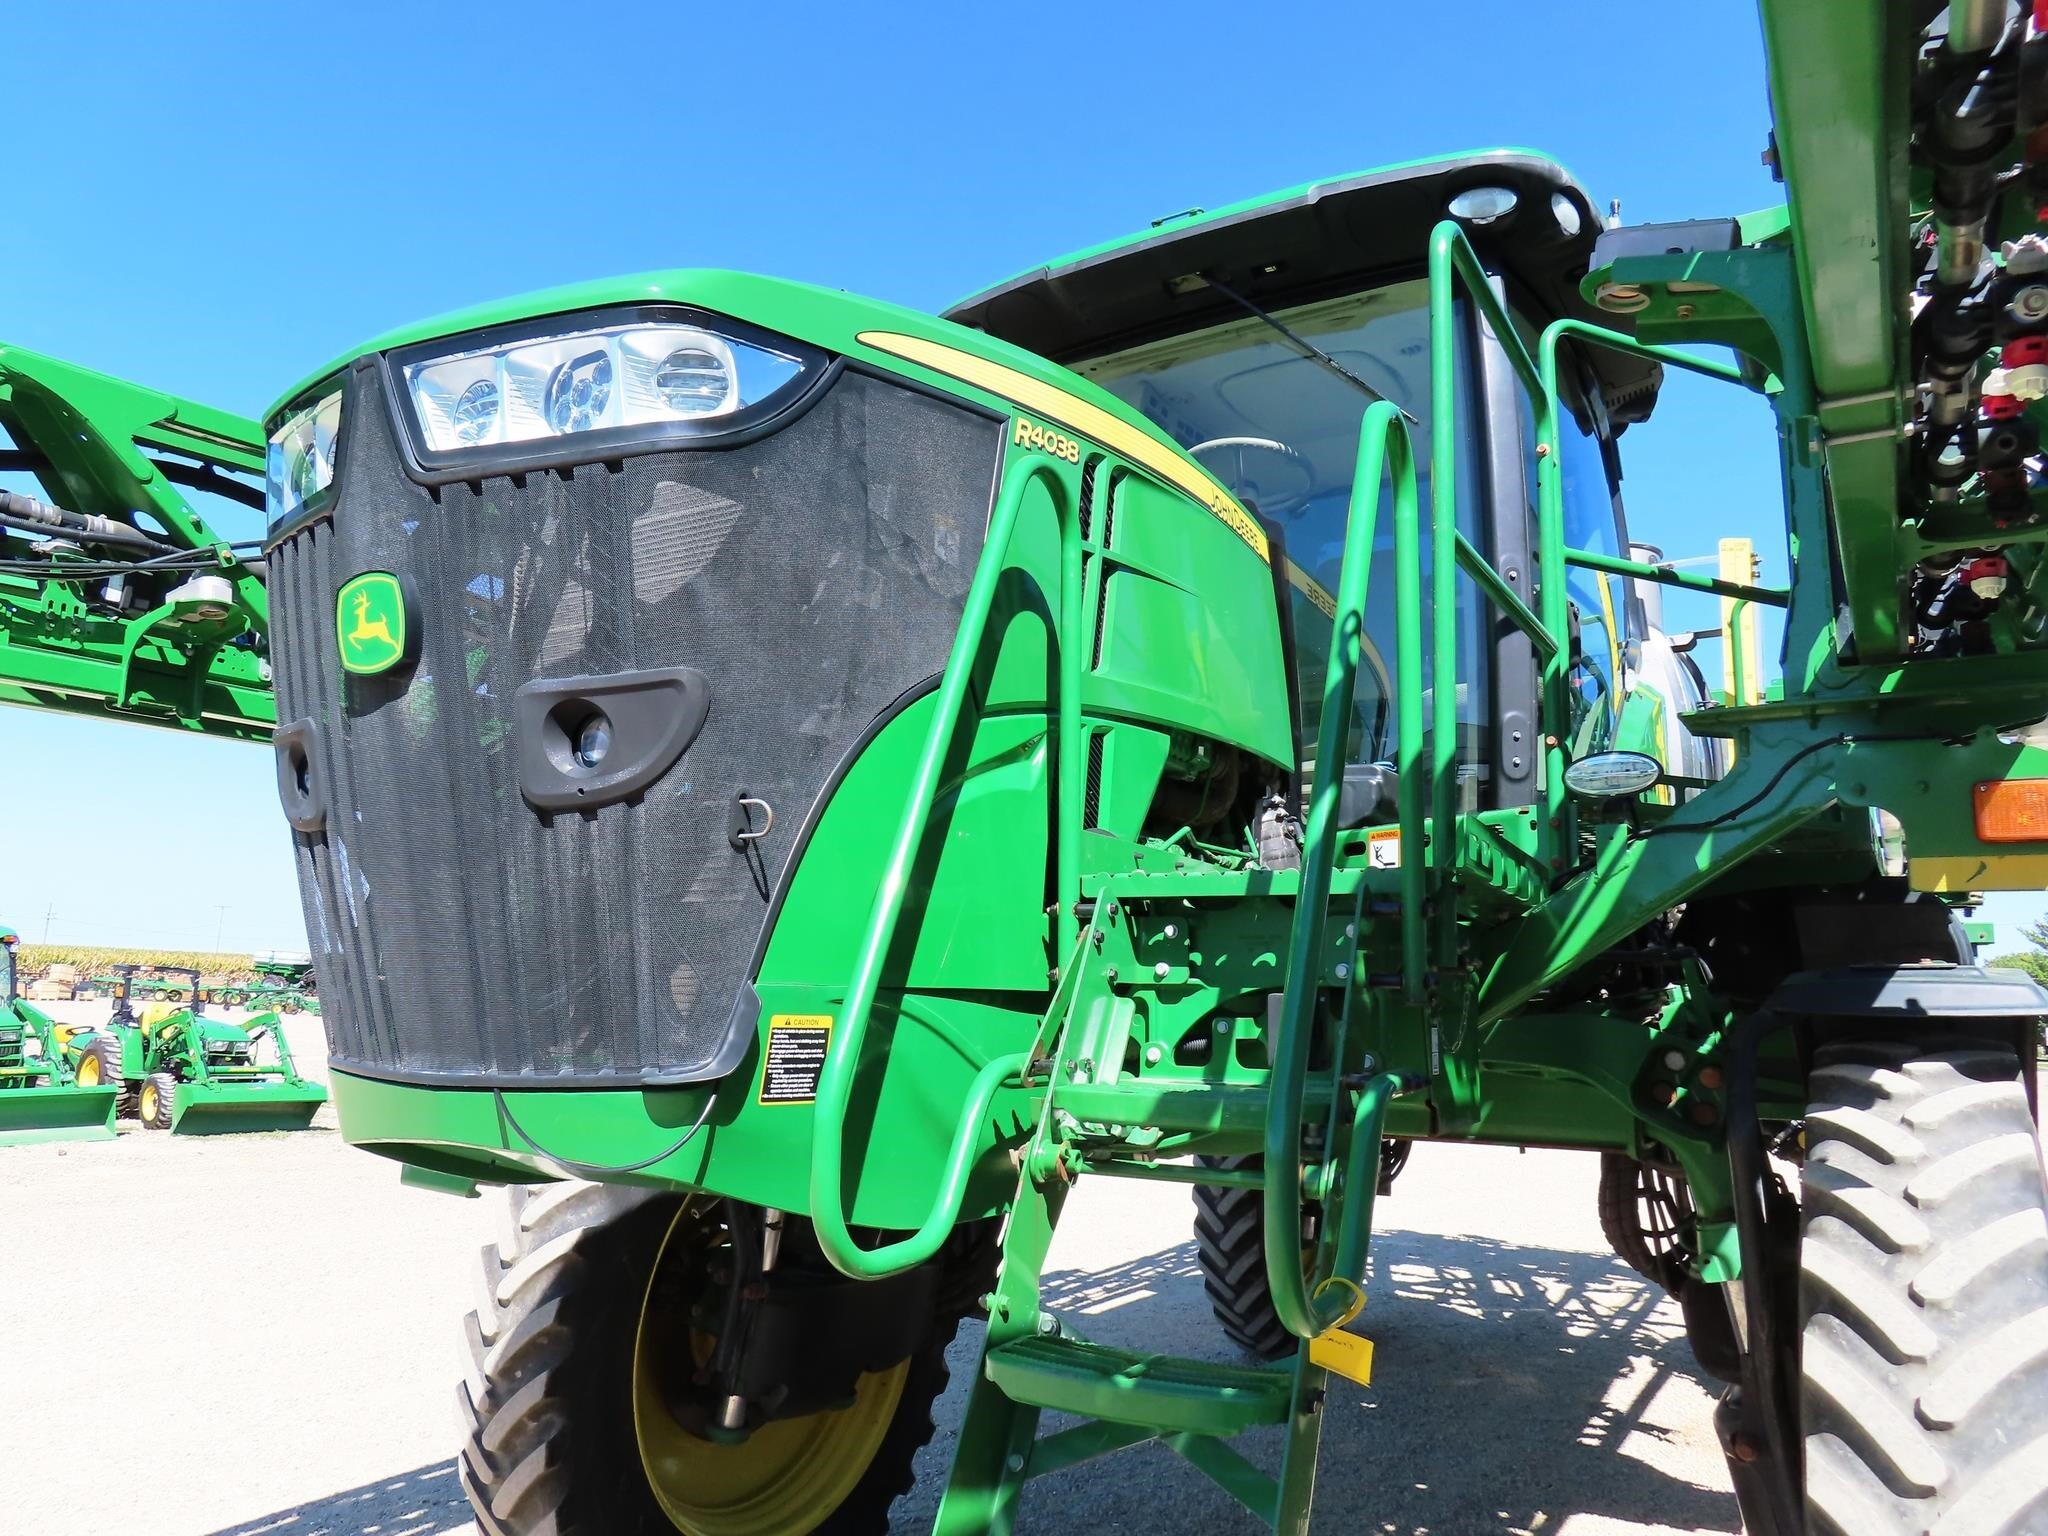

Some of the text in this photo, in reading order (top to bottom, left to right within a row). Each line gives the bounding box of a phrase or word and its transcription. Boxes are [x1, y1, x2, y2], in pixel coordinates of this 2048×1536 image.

[1014, 417, 1079, 465] R4038
[1210, 488, 1260, 552] JOHN DEERE
[1376, 830, 1398, 838] WARNING
